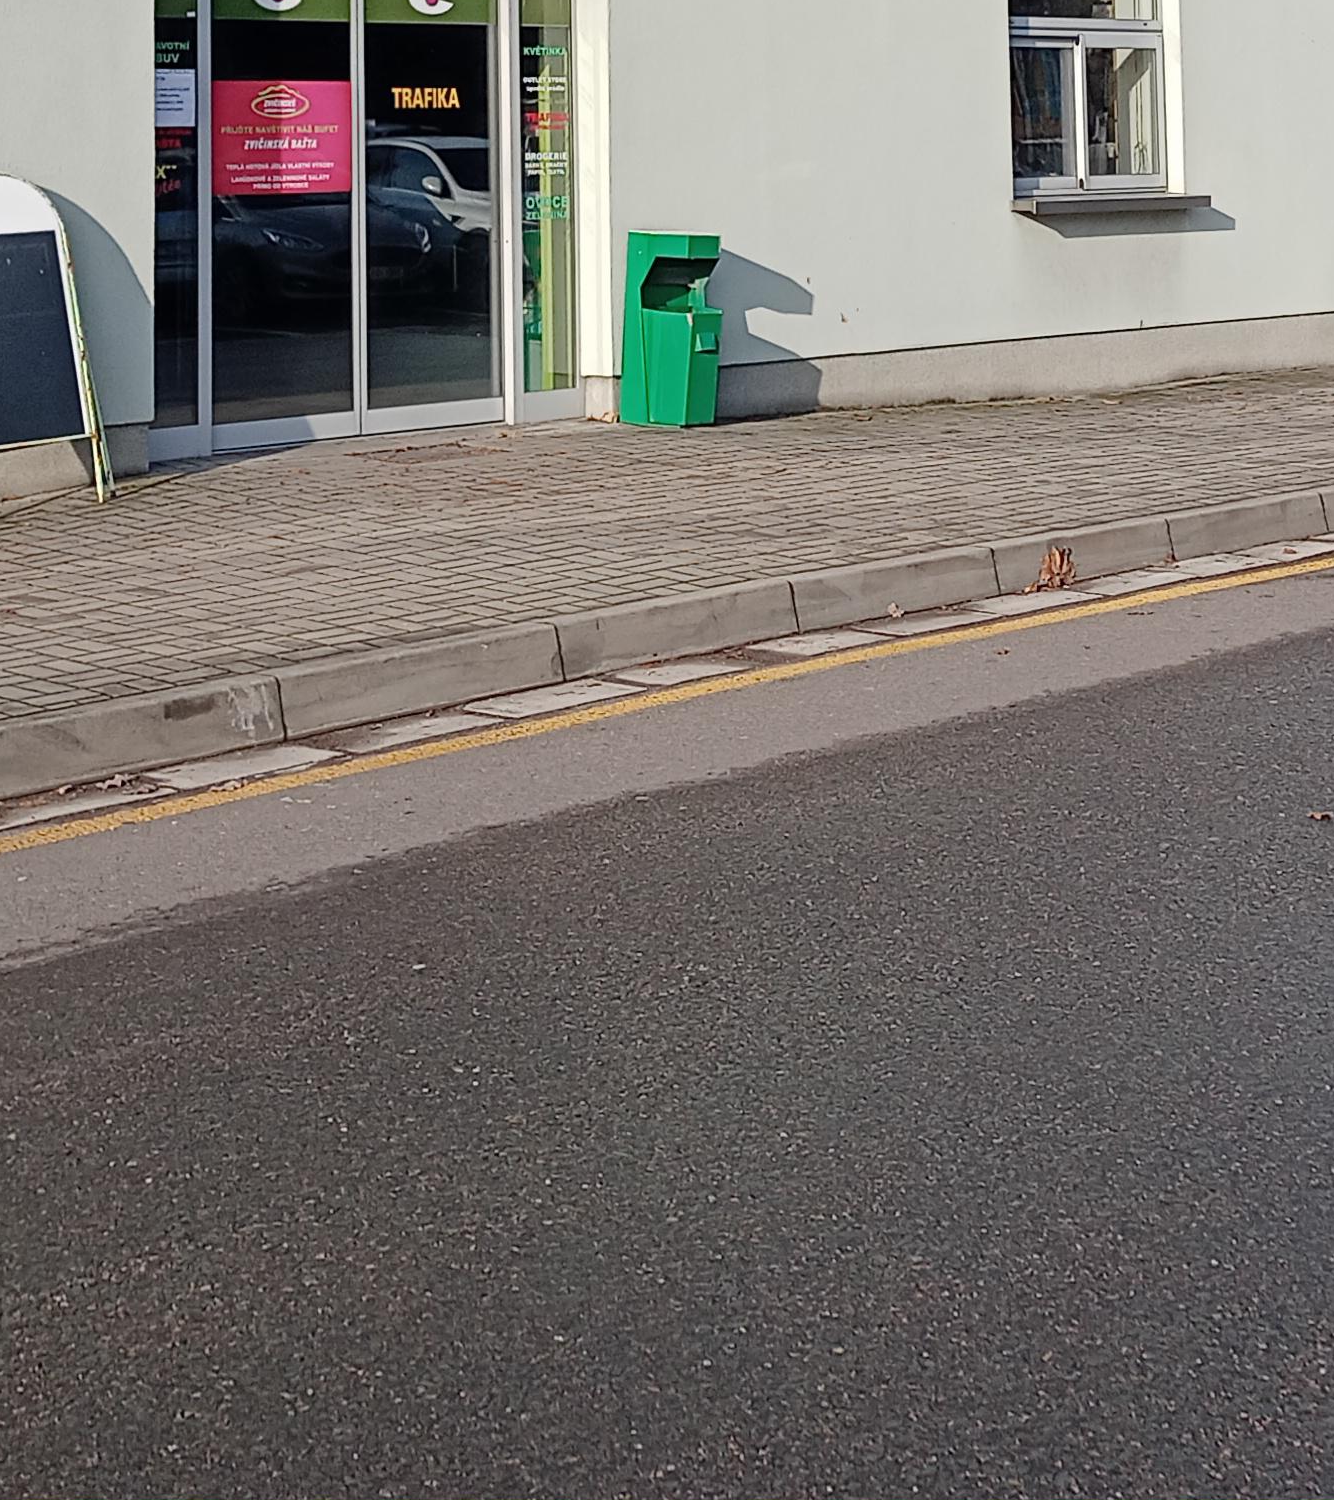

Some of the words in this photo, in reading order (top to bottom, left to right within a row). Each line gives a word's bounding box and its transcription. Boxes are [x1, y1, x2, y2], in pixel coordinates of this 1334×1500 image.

[523, 46, 567, 56] KVĚTINKA
[391, 87, 460, 109] TRAFIKA
[244, 136, 289, 150] ZVIČINSKÁ
[291, 136, 317, 149] BAŠTA
[525, 152, 568, 161] DROGERIE
